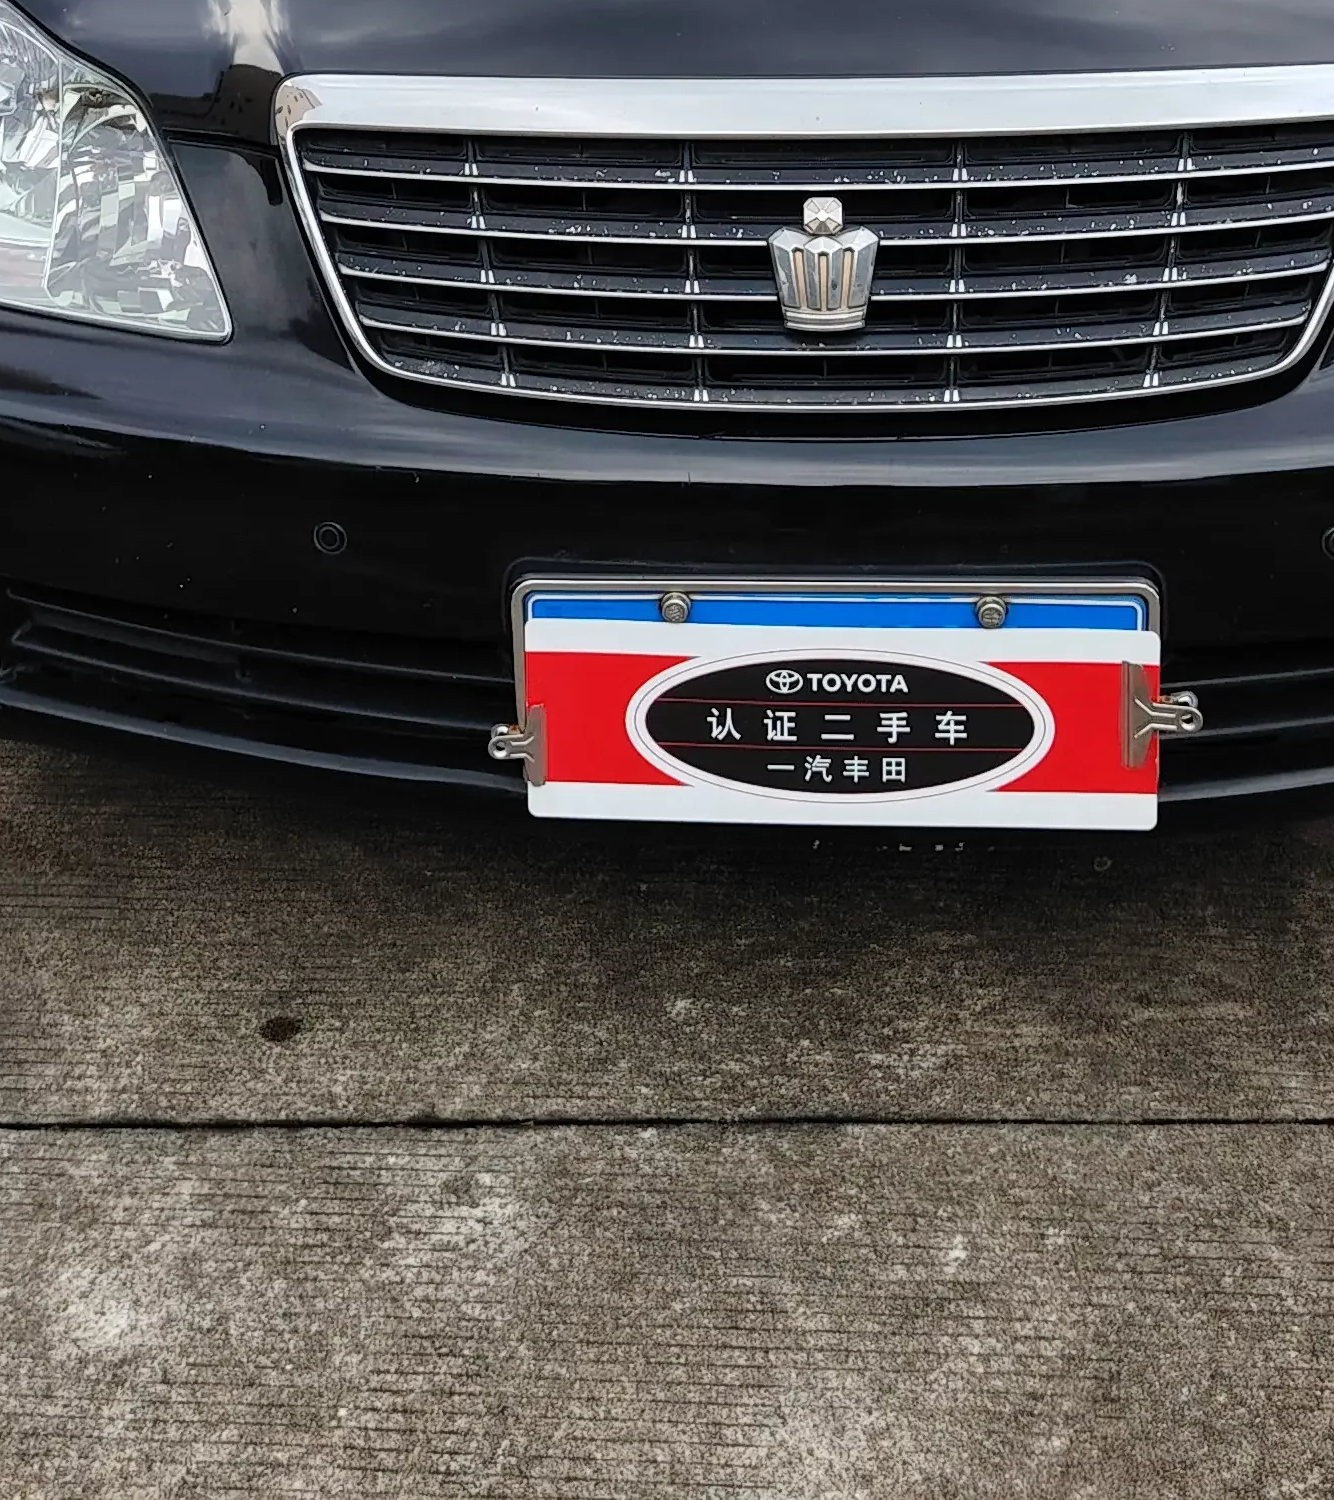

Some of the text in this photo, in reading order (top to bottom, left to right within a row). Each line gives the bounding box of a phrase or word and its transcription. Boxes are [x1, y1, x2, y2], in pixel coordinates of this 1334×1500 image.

[806, 673, 909, 693] TOYOTA
[706, 707, 968, 746] 认证二手车
[766, 755, 907, 784] 一汽丰田
